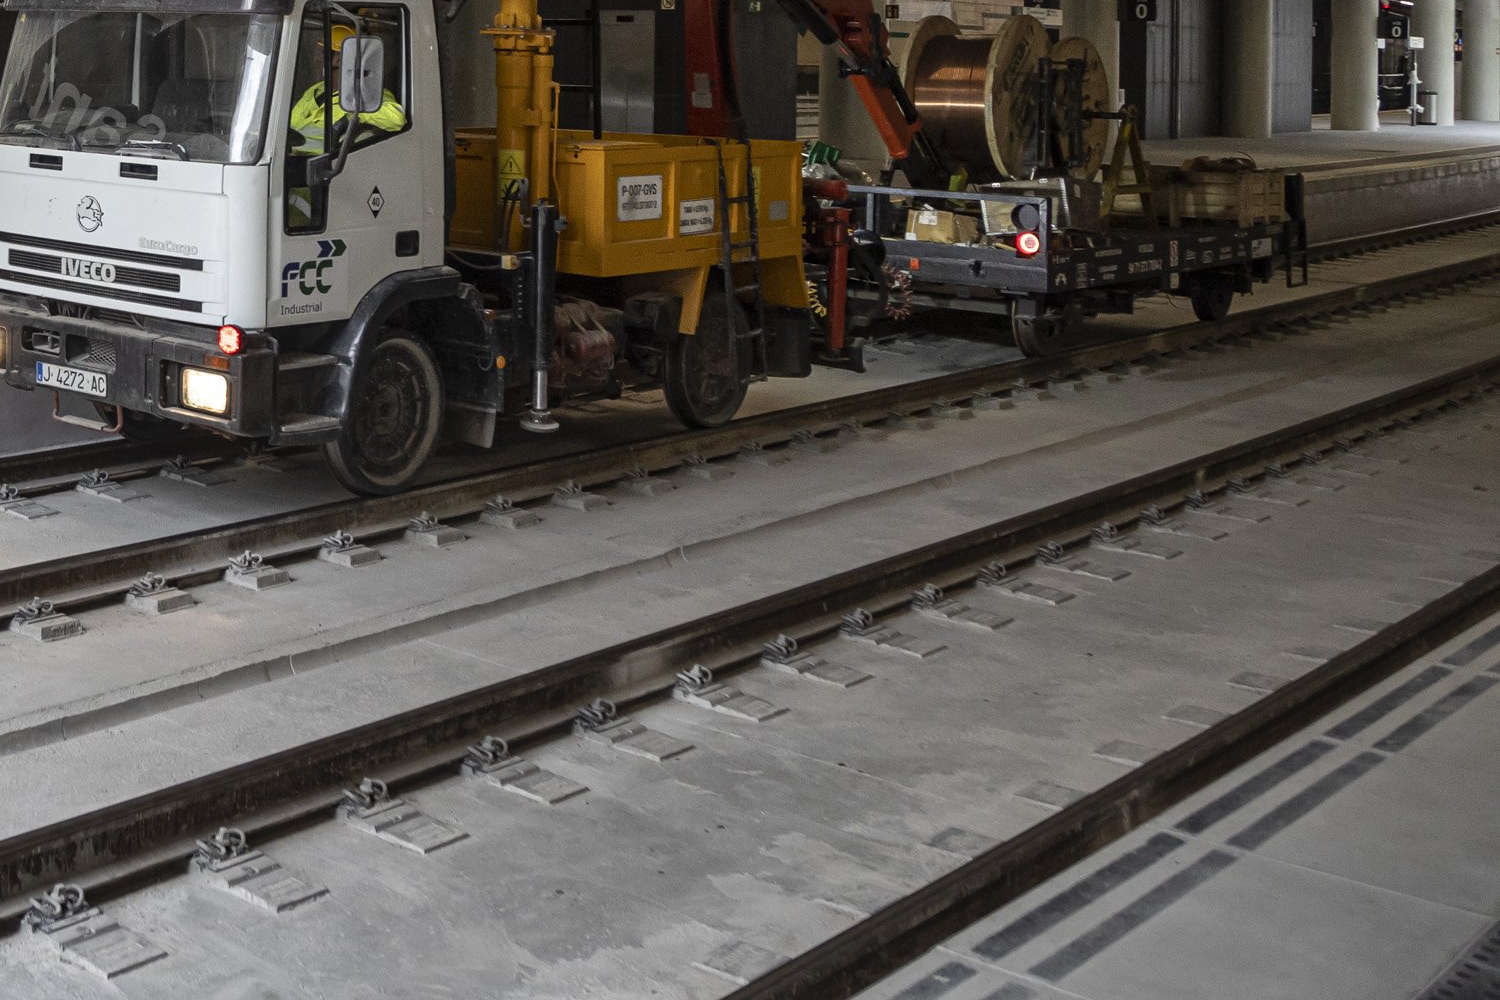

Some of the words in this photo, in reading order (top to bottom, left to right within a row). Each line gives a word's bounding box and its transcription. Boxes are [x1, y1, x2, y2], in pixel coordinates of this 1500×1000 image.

[1135, 3, 1148, 19] 0
[1391, 26, 1402, 38] 0
[371, 197, 381, 207] 40
[61, 256, 117, 283] IVECO
[281, 259, 334, 298] FCC
[280, 301, 323, 316] Industrial
[56, 368, 85, 390] 4272
[91, 375, 105, 393] AC
